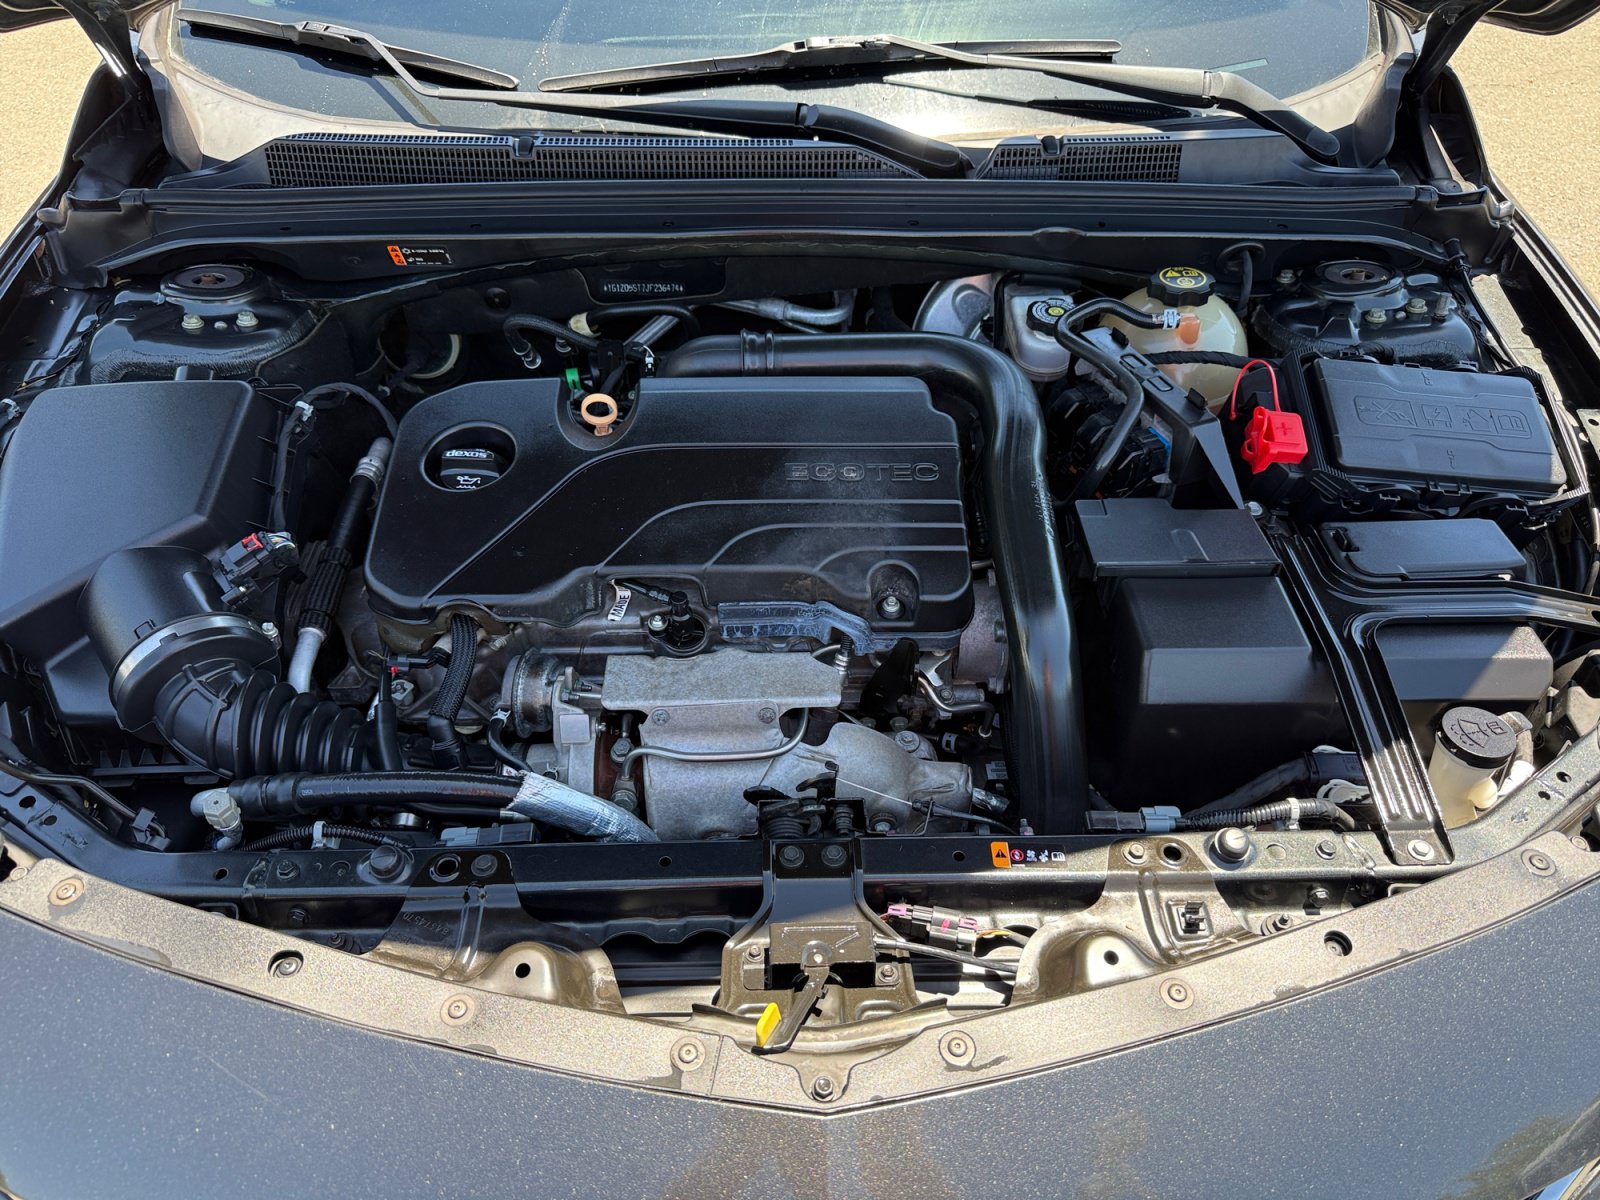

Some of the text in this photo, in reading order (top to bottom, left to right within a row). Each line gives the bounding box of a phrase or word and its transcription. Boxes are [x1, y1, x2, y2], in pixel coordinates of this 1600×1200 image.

[445, 449, 487, 458] dexos
[784, 462, 940, 482] ECOTEC
[610, 594, 630, 618] MADE
